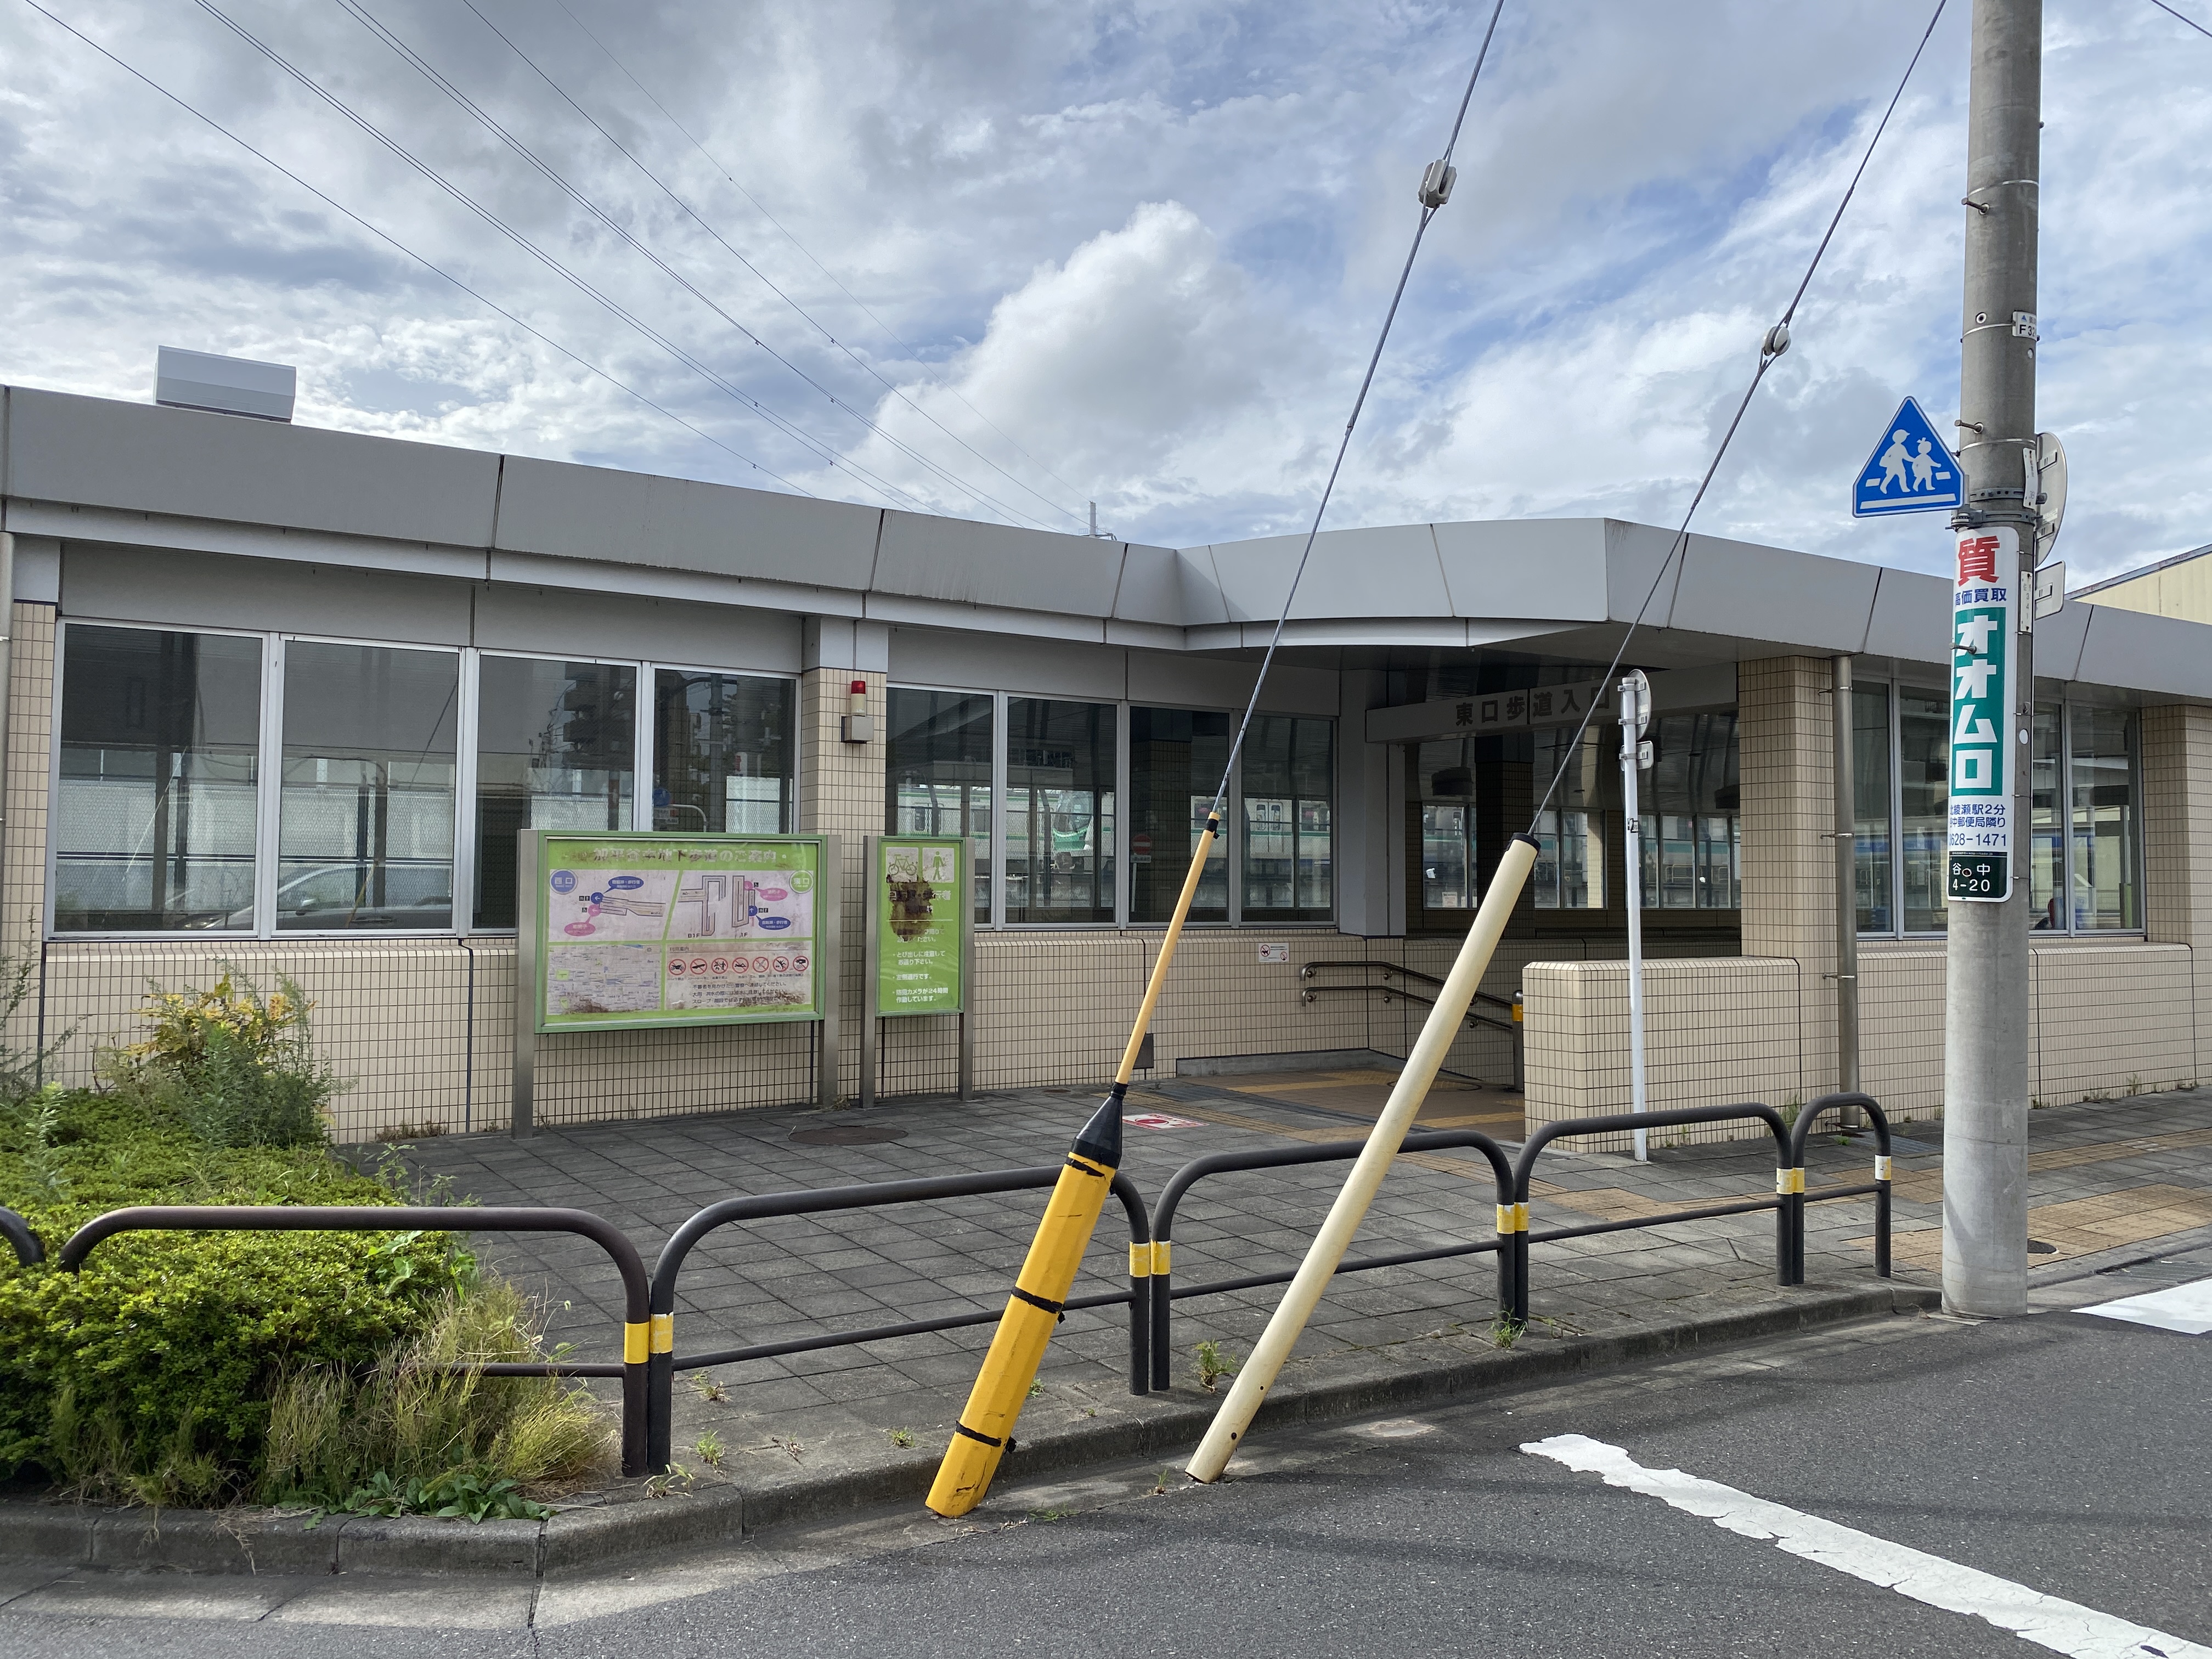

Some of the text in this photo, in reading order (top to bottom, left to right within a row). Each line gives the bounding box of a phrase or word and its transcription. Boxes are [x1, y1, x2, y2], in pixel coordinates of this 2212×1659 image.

[1958, 535, 2000, 587] 質
[1455, 687, 1610, 726] 東口歩道入口
[1954, 614, 1998, 789] オオムロ
[1953, 878, 1990, 892] 4-20
